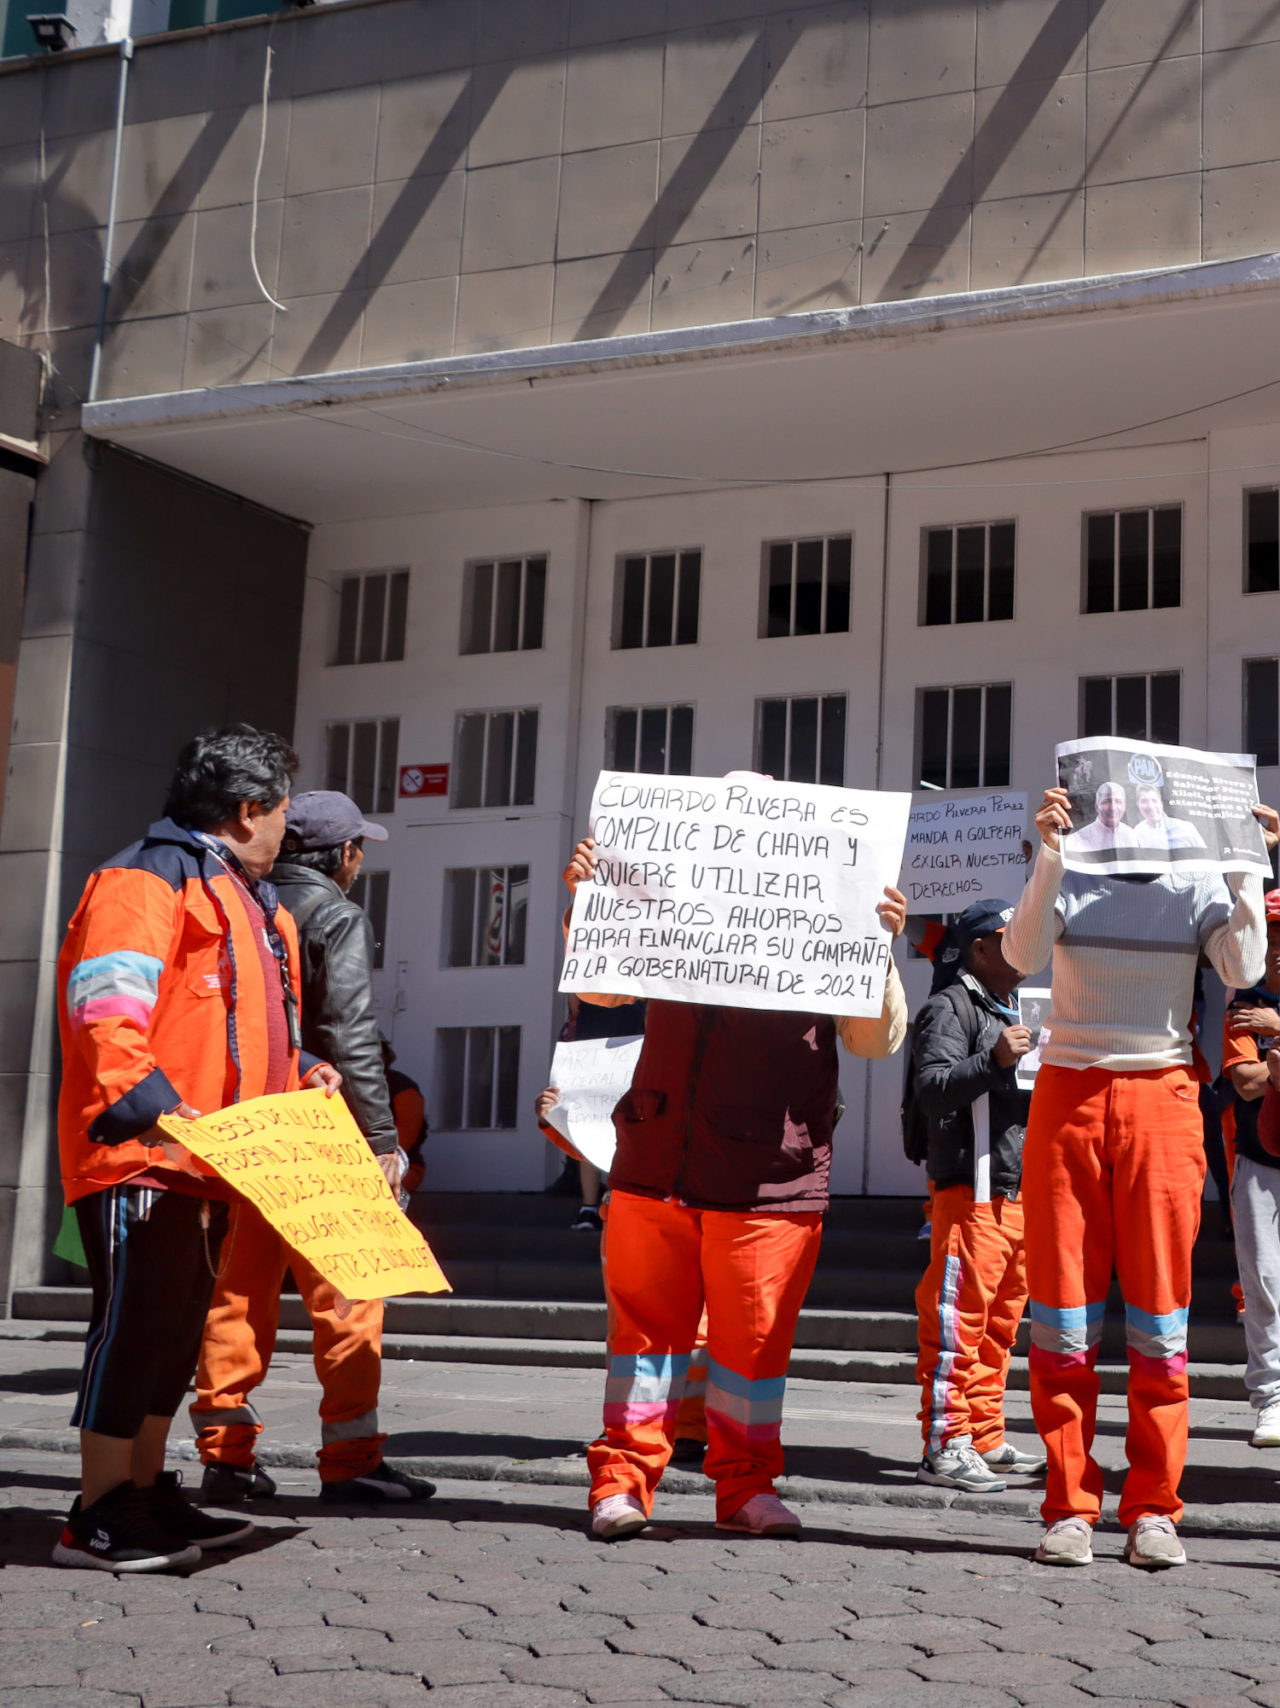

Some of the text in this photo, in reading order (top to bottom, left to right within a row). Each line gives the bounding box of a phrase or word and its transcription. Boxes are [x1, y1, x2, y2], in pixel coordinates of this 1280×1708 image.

[599, 776, 869, 827] EDUARDO RIVERA ES
[594, 815, 701, 853] COMPLICE
[714, 825, 746, 854] DE
[757, 831, 829, 860] CHAVA
[910, 825, 1022, 845] MANDA A GOLPEAR
[911, 854, 962, 869] EXIGIR
[966, 852, 1027, 868] NUESTROS
[593, 859, 825, 903] QUIERE UTILIZAR
[909, 878, 983, 900] DERECHOS
[584, 892, 843, 935] NUESTROS AHORROS
[573, 927, 890, 968] PARA FINANCIAR SU CAMPAÑA
[564, 959, 579, 982] A
[583, 955, 608, 980] LA
[617, 956, 770, 988] GOBERNATURA
[777, 969, 806, 995] DE
[254, 1108, 290, 1126] DE
